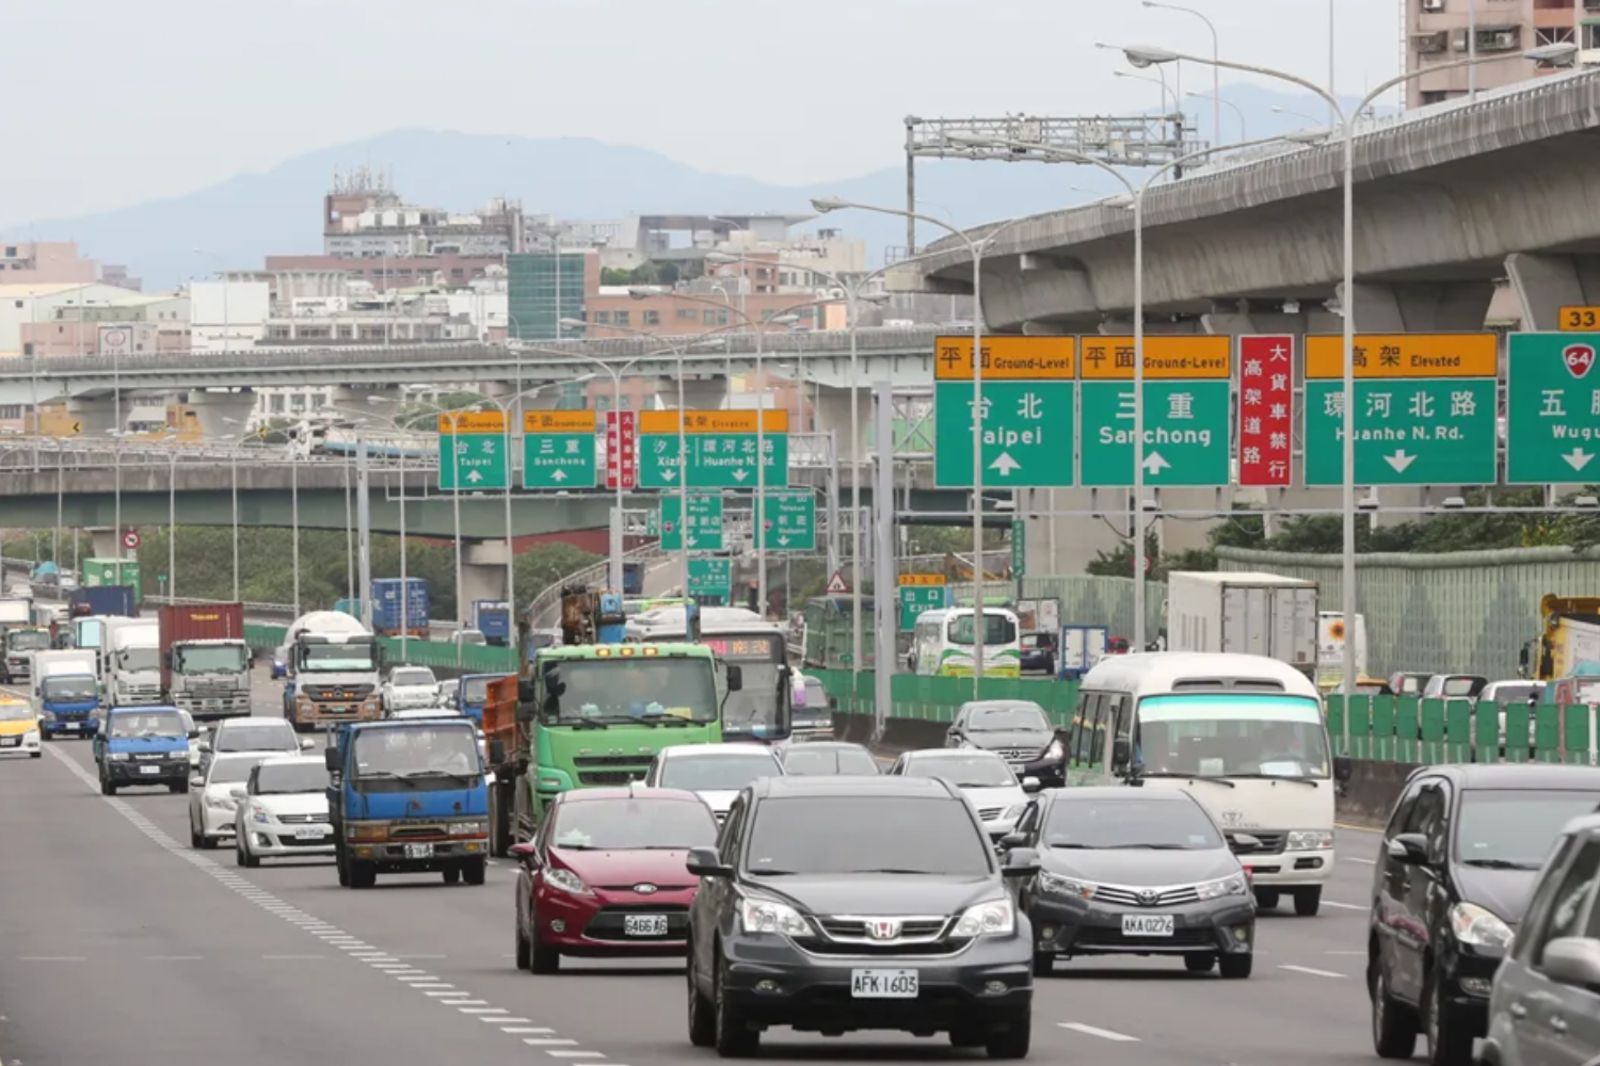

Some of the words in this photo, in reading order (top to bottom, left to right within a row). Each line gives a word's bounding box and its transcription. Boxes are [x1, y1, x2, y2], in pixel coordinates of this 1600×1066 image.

[1569, 311, 1596, 328] 33
[940, 346, 992, 369] 平面
[994, 356, 1071, 369] Ground-Level
[1085, 346, 1136, 369] 平面
[1142, 356, 1226, 369] Ground-Level
[1410, 354, 1461, 367] Elevated
[1567, 352, 1590, 366] 64
[966, 391, 1043, 419] 台北
[1115, 392, 1195, 419] 三重
[1434, 425, 1465, 440] Rd.
